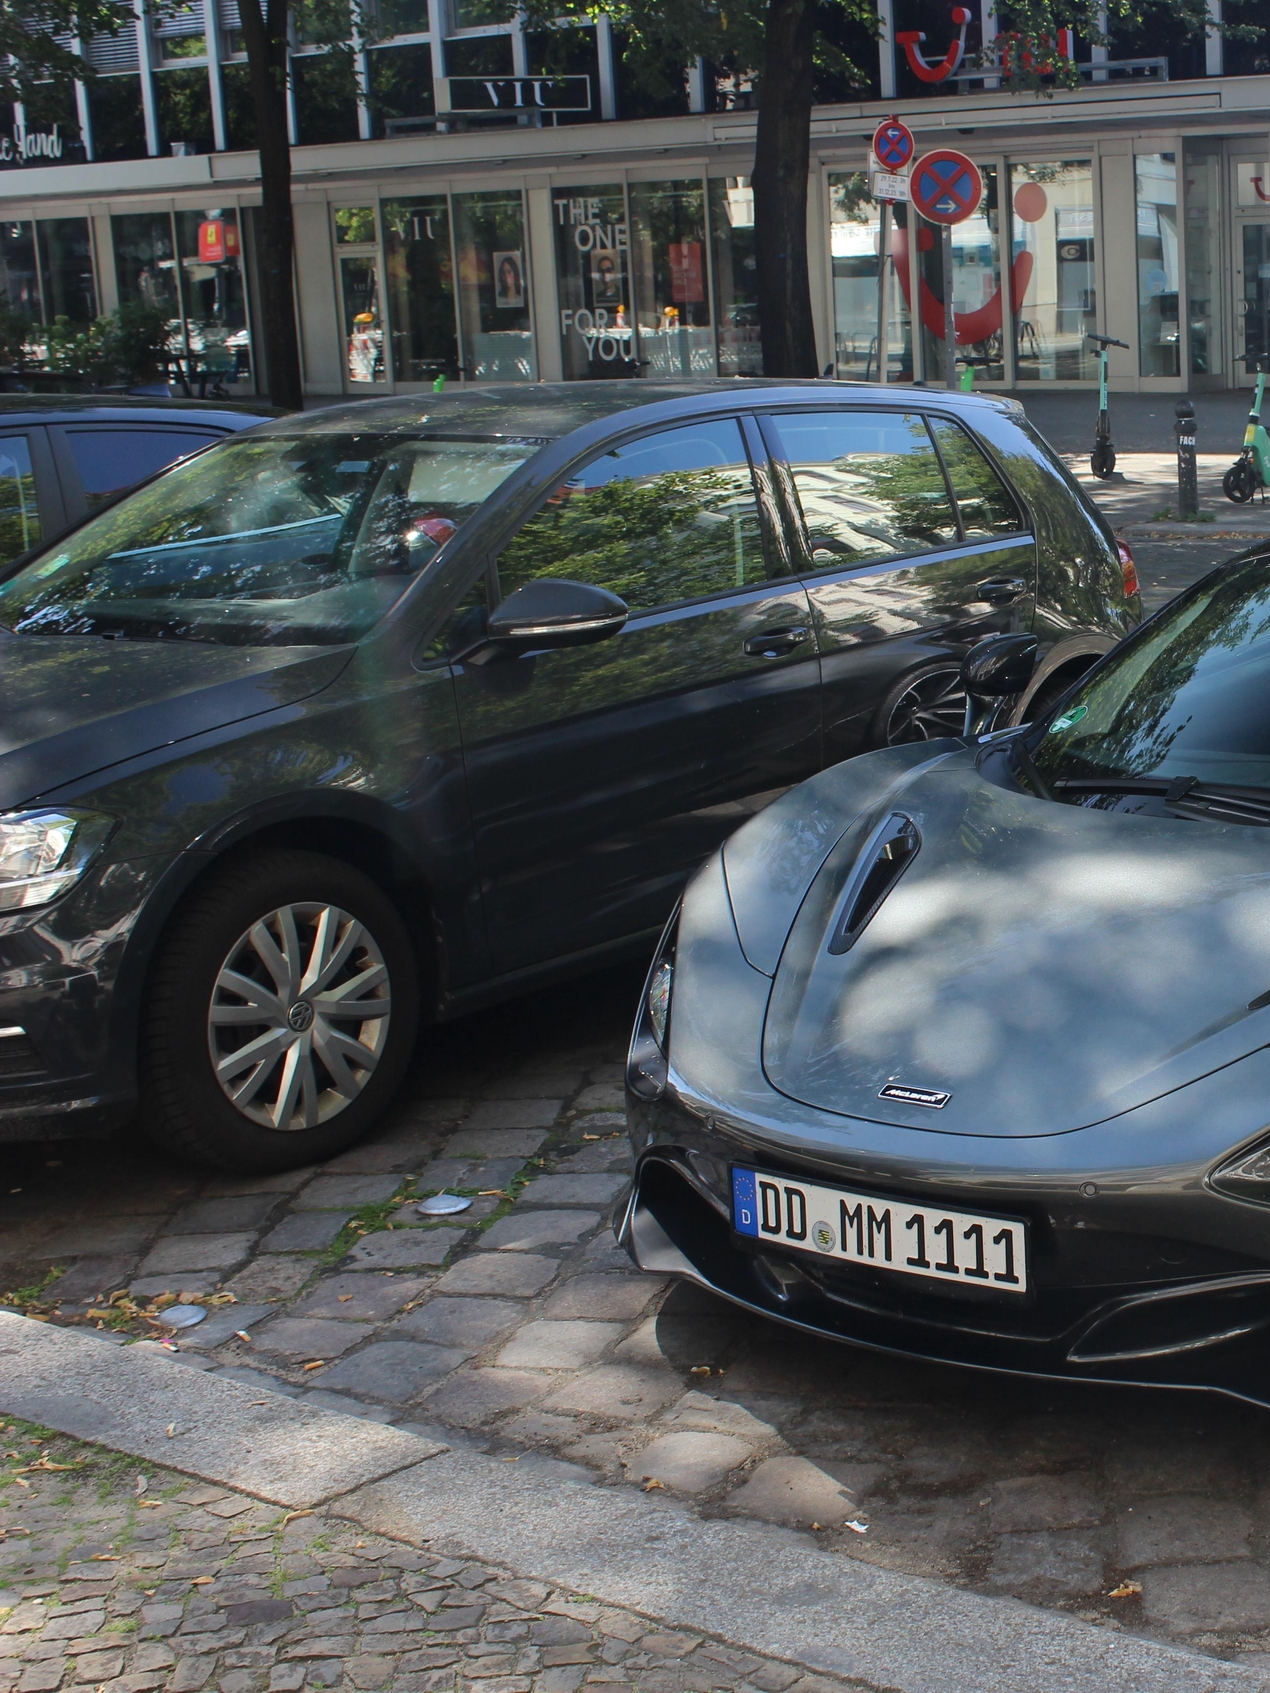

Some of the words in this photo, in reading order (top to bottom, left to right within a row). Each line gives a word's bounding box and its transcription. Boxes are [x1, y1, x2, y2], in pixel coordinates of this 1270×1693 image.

[483, 81, 555, 107] VIU
[554, 198, 600, 225] THE
[394, 215, 441, 241] VIU
[574, 224, 628, 252] ONE
[561, 308, 608, 336] FOR
[582, 335, 634, 362] YOU
[885, 1088, 937, 1102] McLaren
[741, 1209, 751, 1225] D
[758, 1180, 808, 1241] DD
[839, 1198, 893, 1262] MM
[905, 1213, 1020, 1284] 1111
